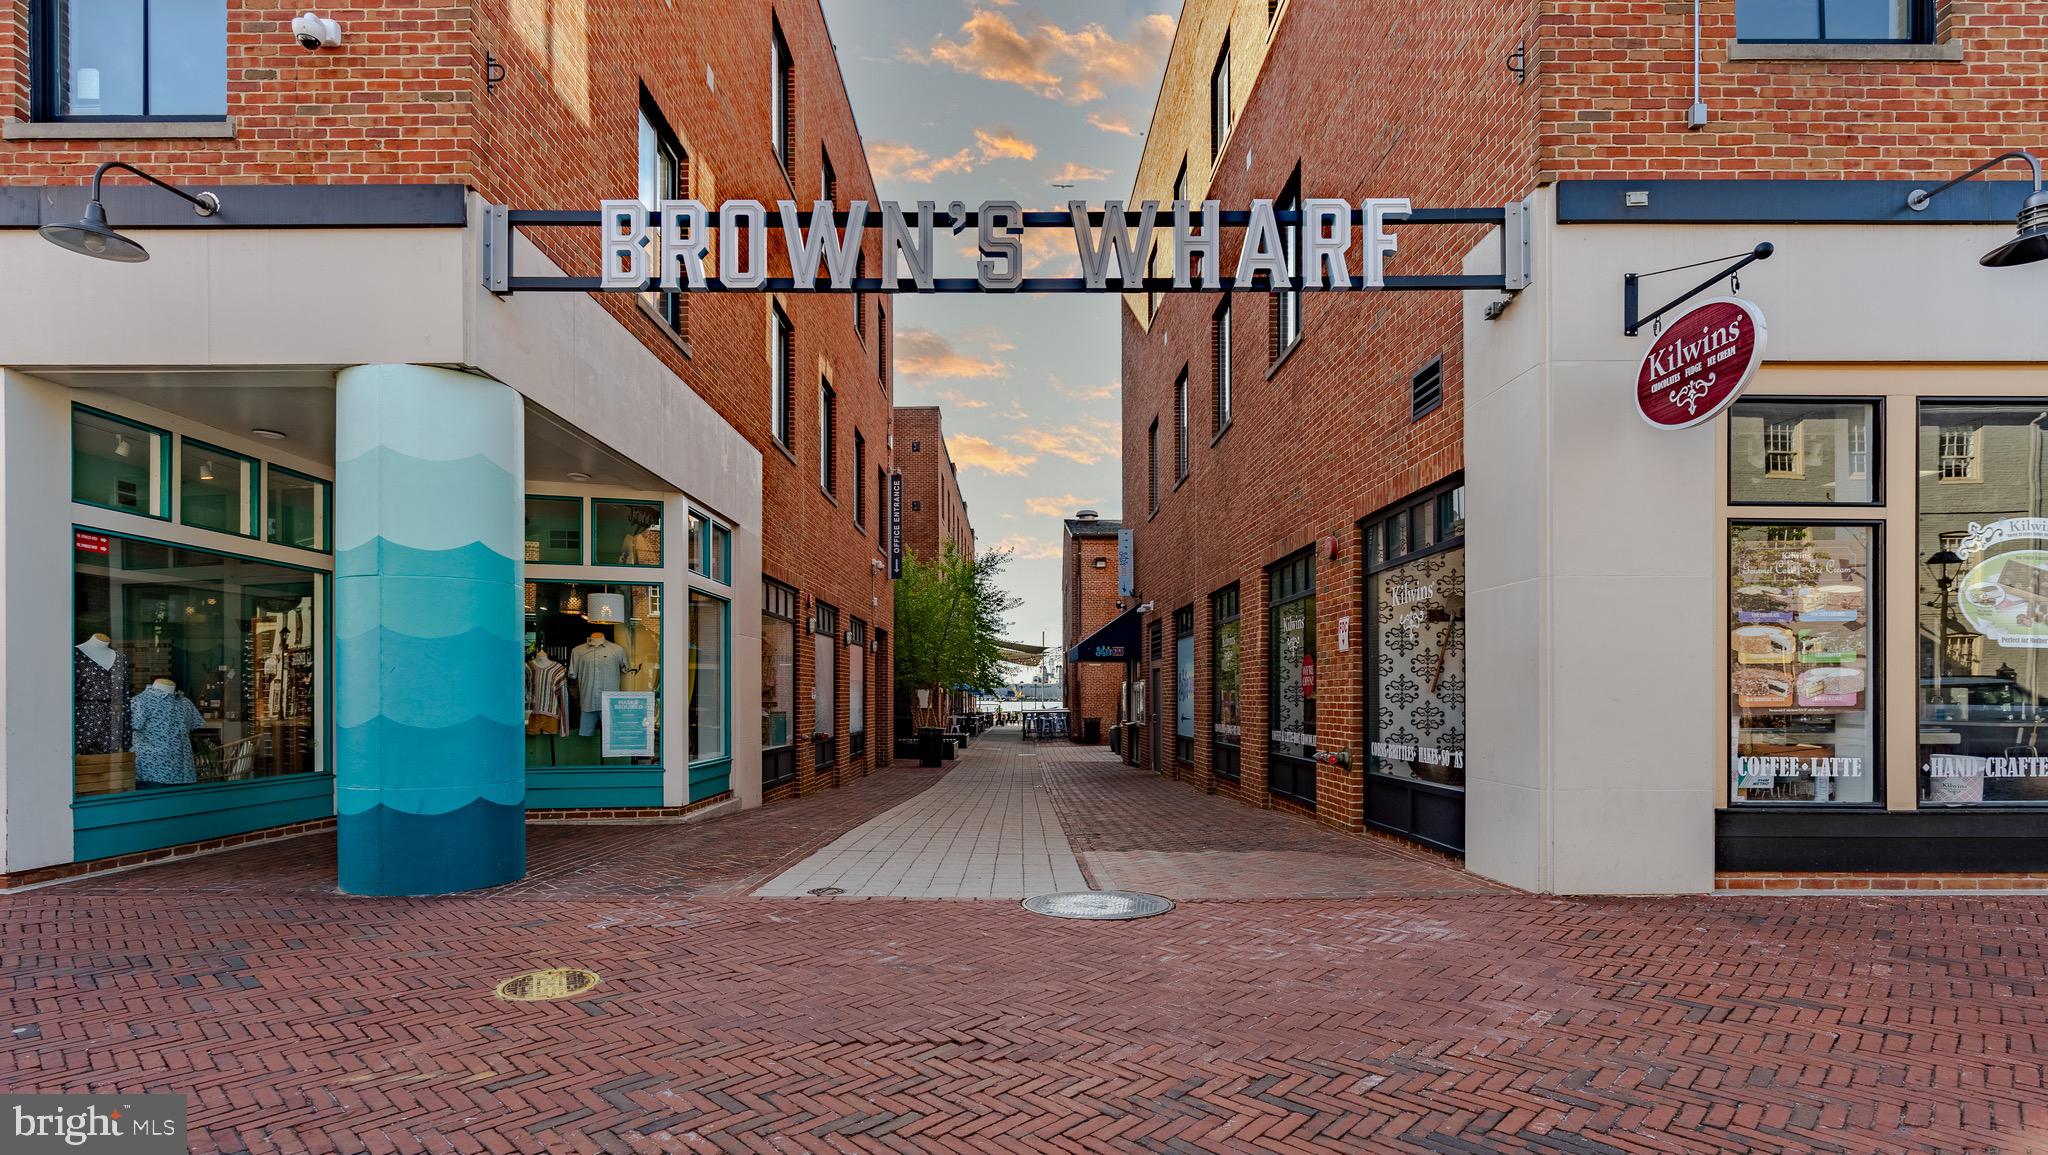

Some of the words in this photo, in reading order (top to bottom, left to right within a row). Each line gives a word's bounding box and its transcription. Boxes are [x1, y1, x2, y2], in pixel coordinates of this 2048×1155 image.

[600, 199, 1023, 292] BROWN'S
[1068, 198, 1412, 292] WHARF
[1648, 315, 1742, 382] Kilwins
[1651, 372, 1681, 393] CHOCOLATES
[1685, 362, 1702, 378] FUDGE
[1707, 353, 1717, 367] ICE
[1717, 345, 1736, 362] CREAM
[1742, 560, 1773, 575] Gourmet
[1826, 559, 1852, 574] Cream
[1392, 581, 1434, 606] Kilwins
[1738, 756, 1799, 777] COFFEE
[1810, 757, 1861, 777] LATTE
